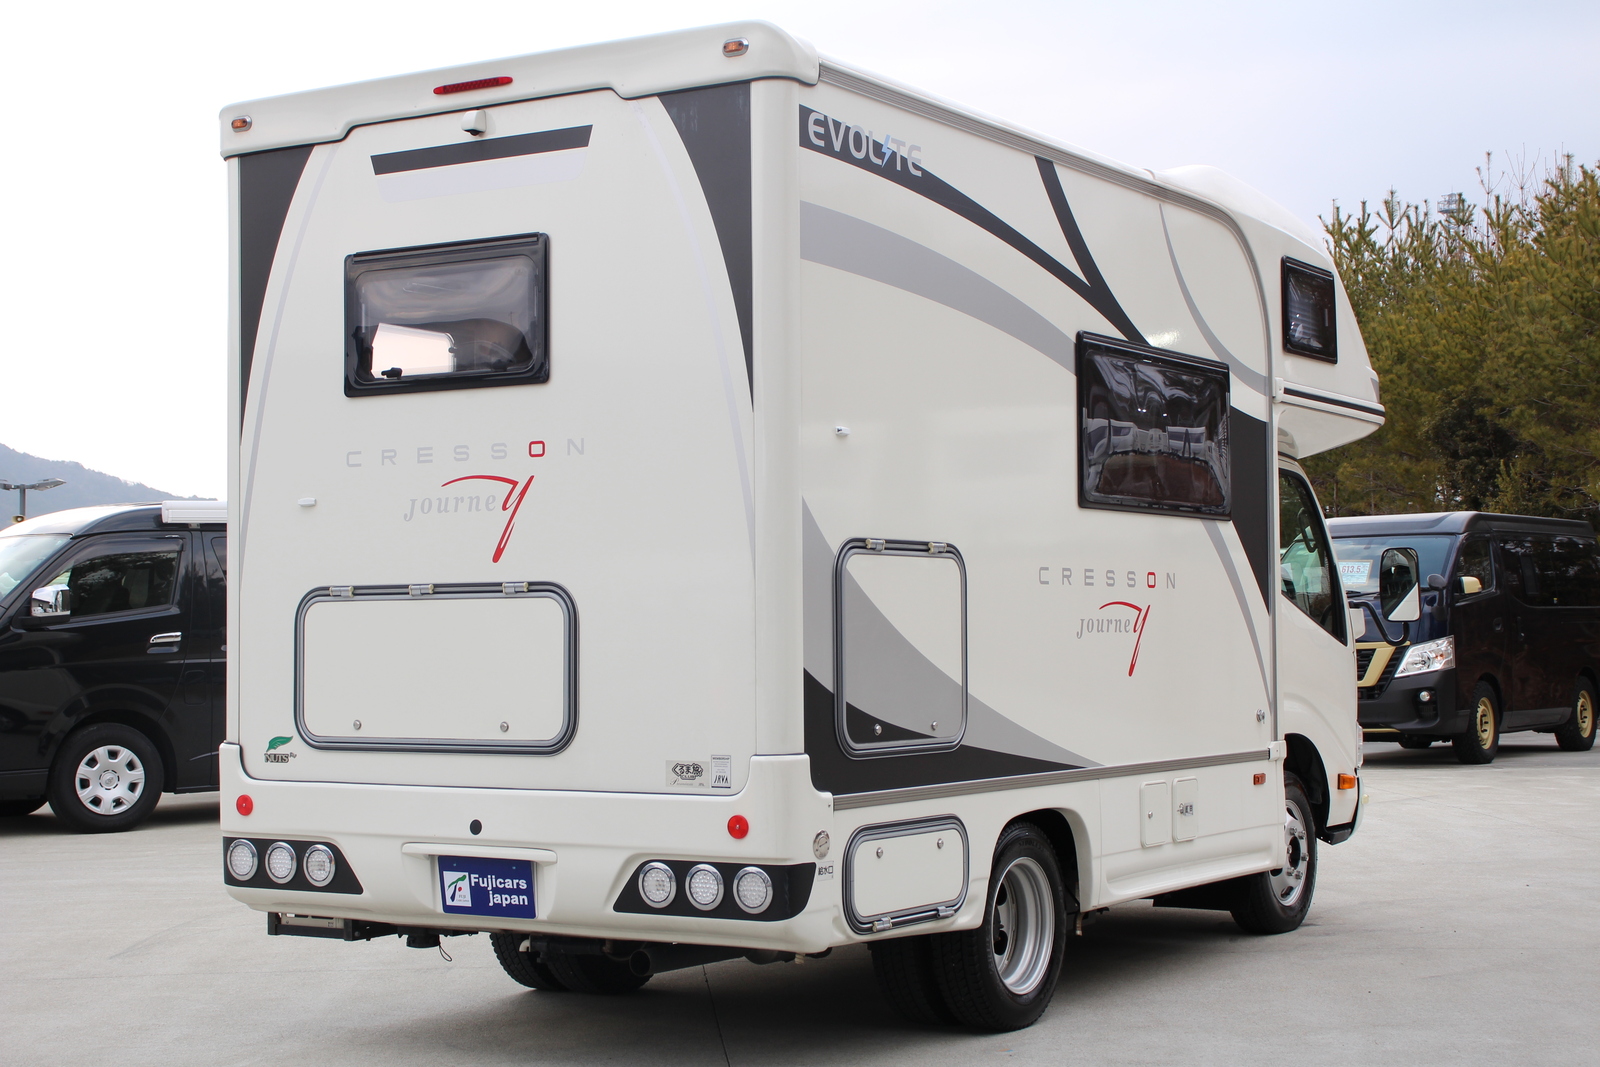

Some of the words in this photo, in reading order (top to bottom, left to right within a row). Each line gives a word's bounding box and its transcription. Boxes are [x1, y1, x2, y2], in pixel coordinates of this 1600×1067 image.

[346, 437, 585, 468] CRESSON
[1038, 566, 1176, 590] CRESSON
[470, 873, 528, 891] Fujicars
[488, 890, 529, 908] japan
